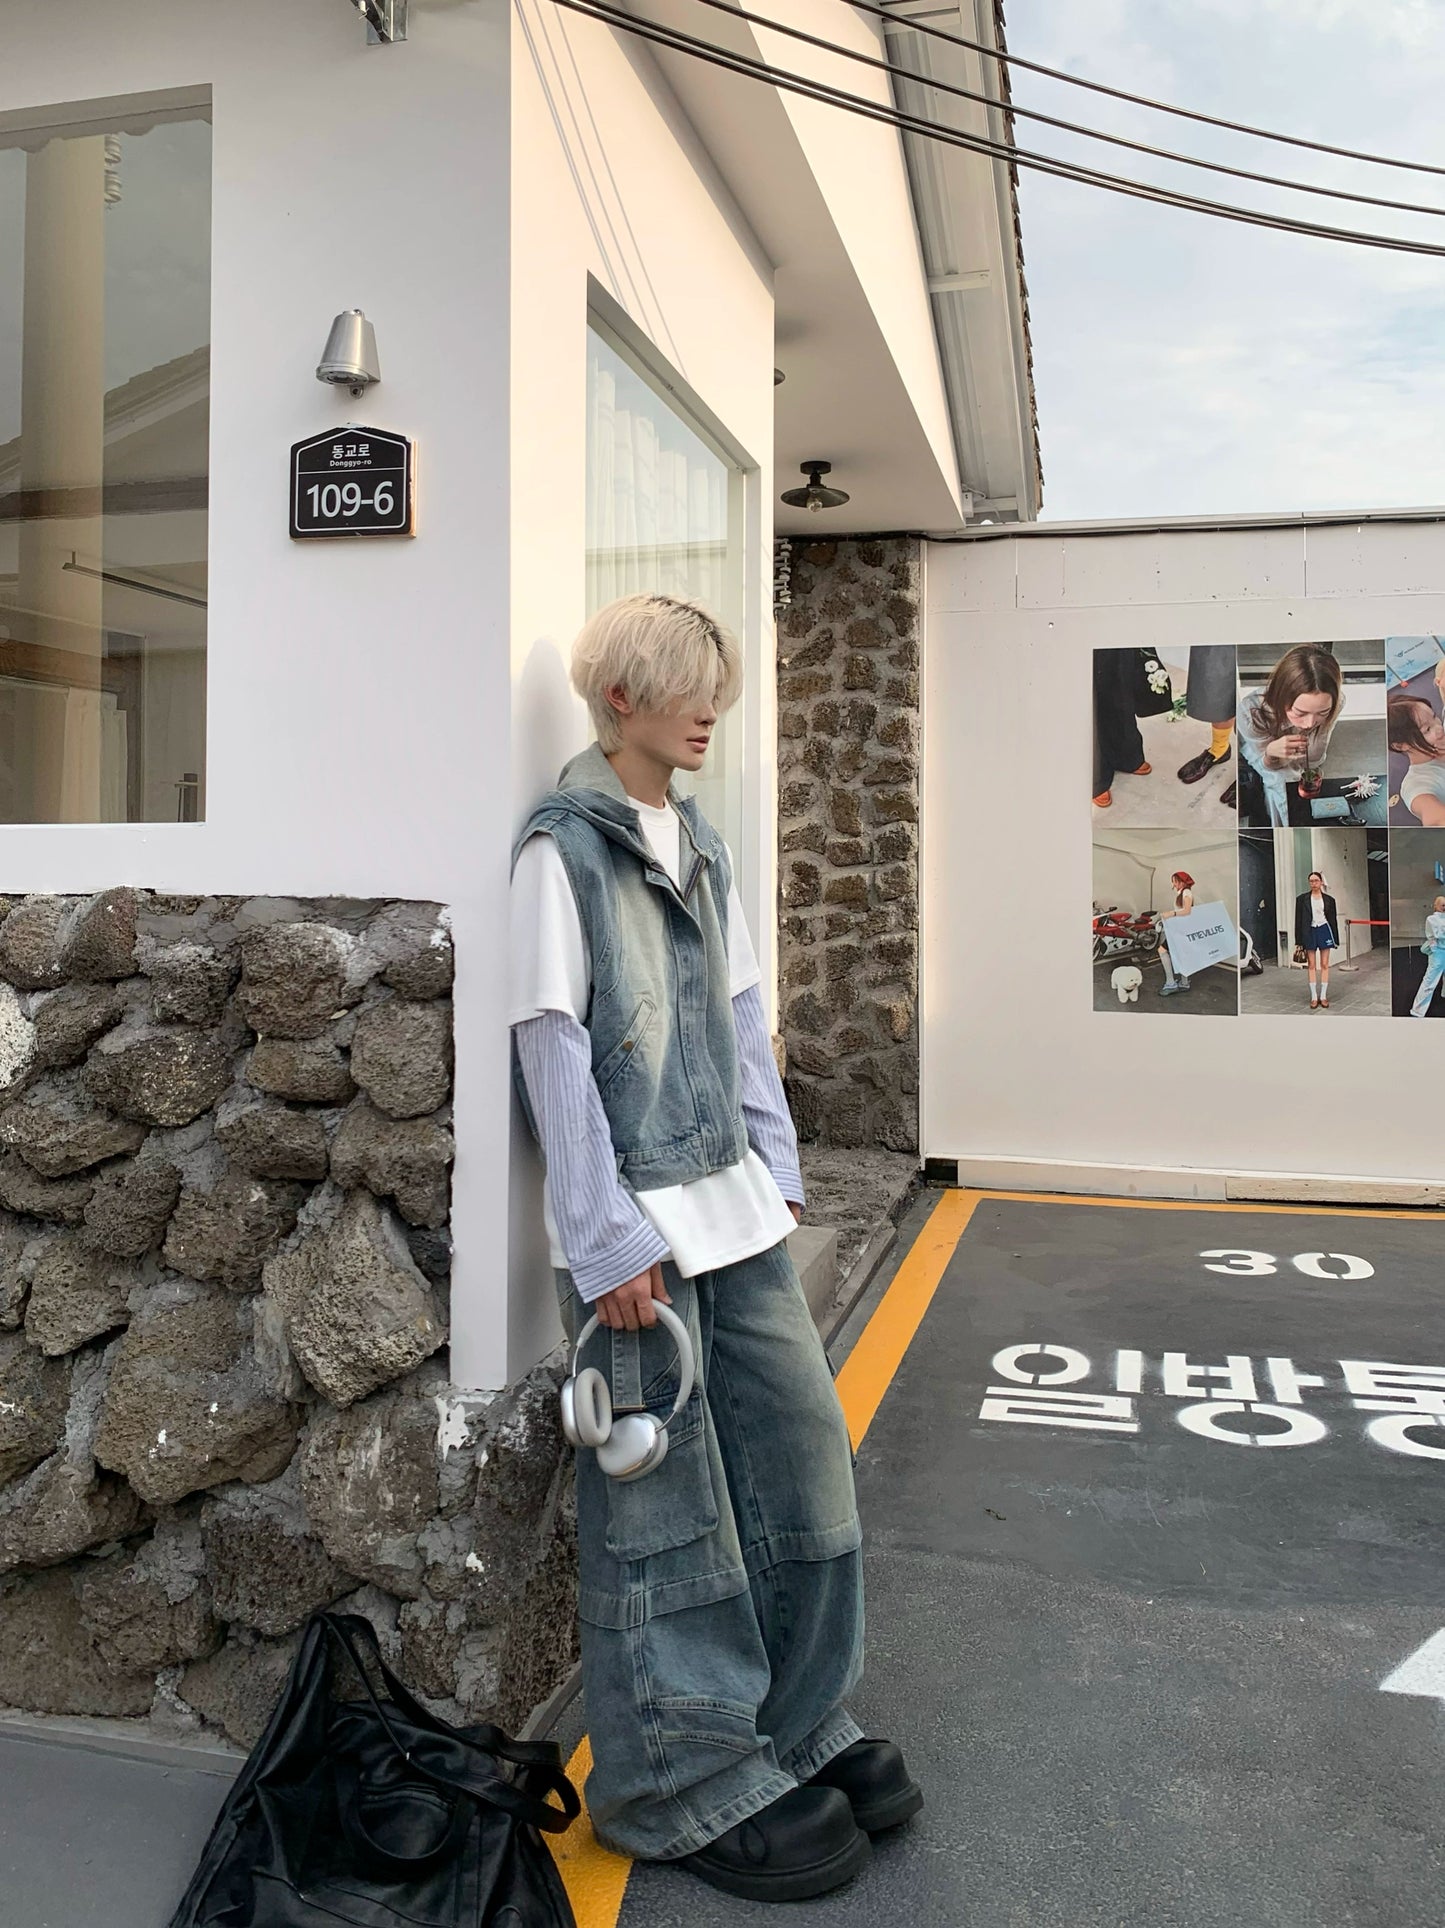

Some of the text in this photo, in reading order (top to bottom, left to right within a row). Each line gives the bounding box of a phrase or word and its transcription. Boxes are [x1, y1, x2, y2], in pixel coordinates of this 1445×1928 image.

[329, 458, 372, 467] Donggyo-ro
[332, 443, 370, 459] 동교로
[306, 480, 395, 518] 109-6
[1199, 1248, 1376, 1281] 30
